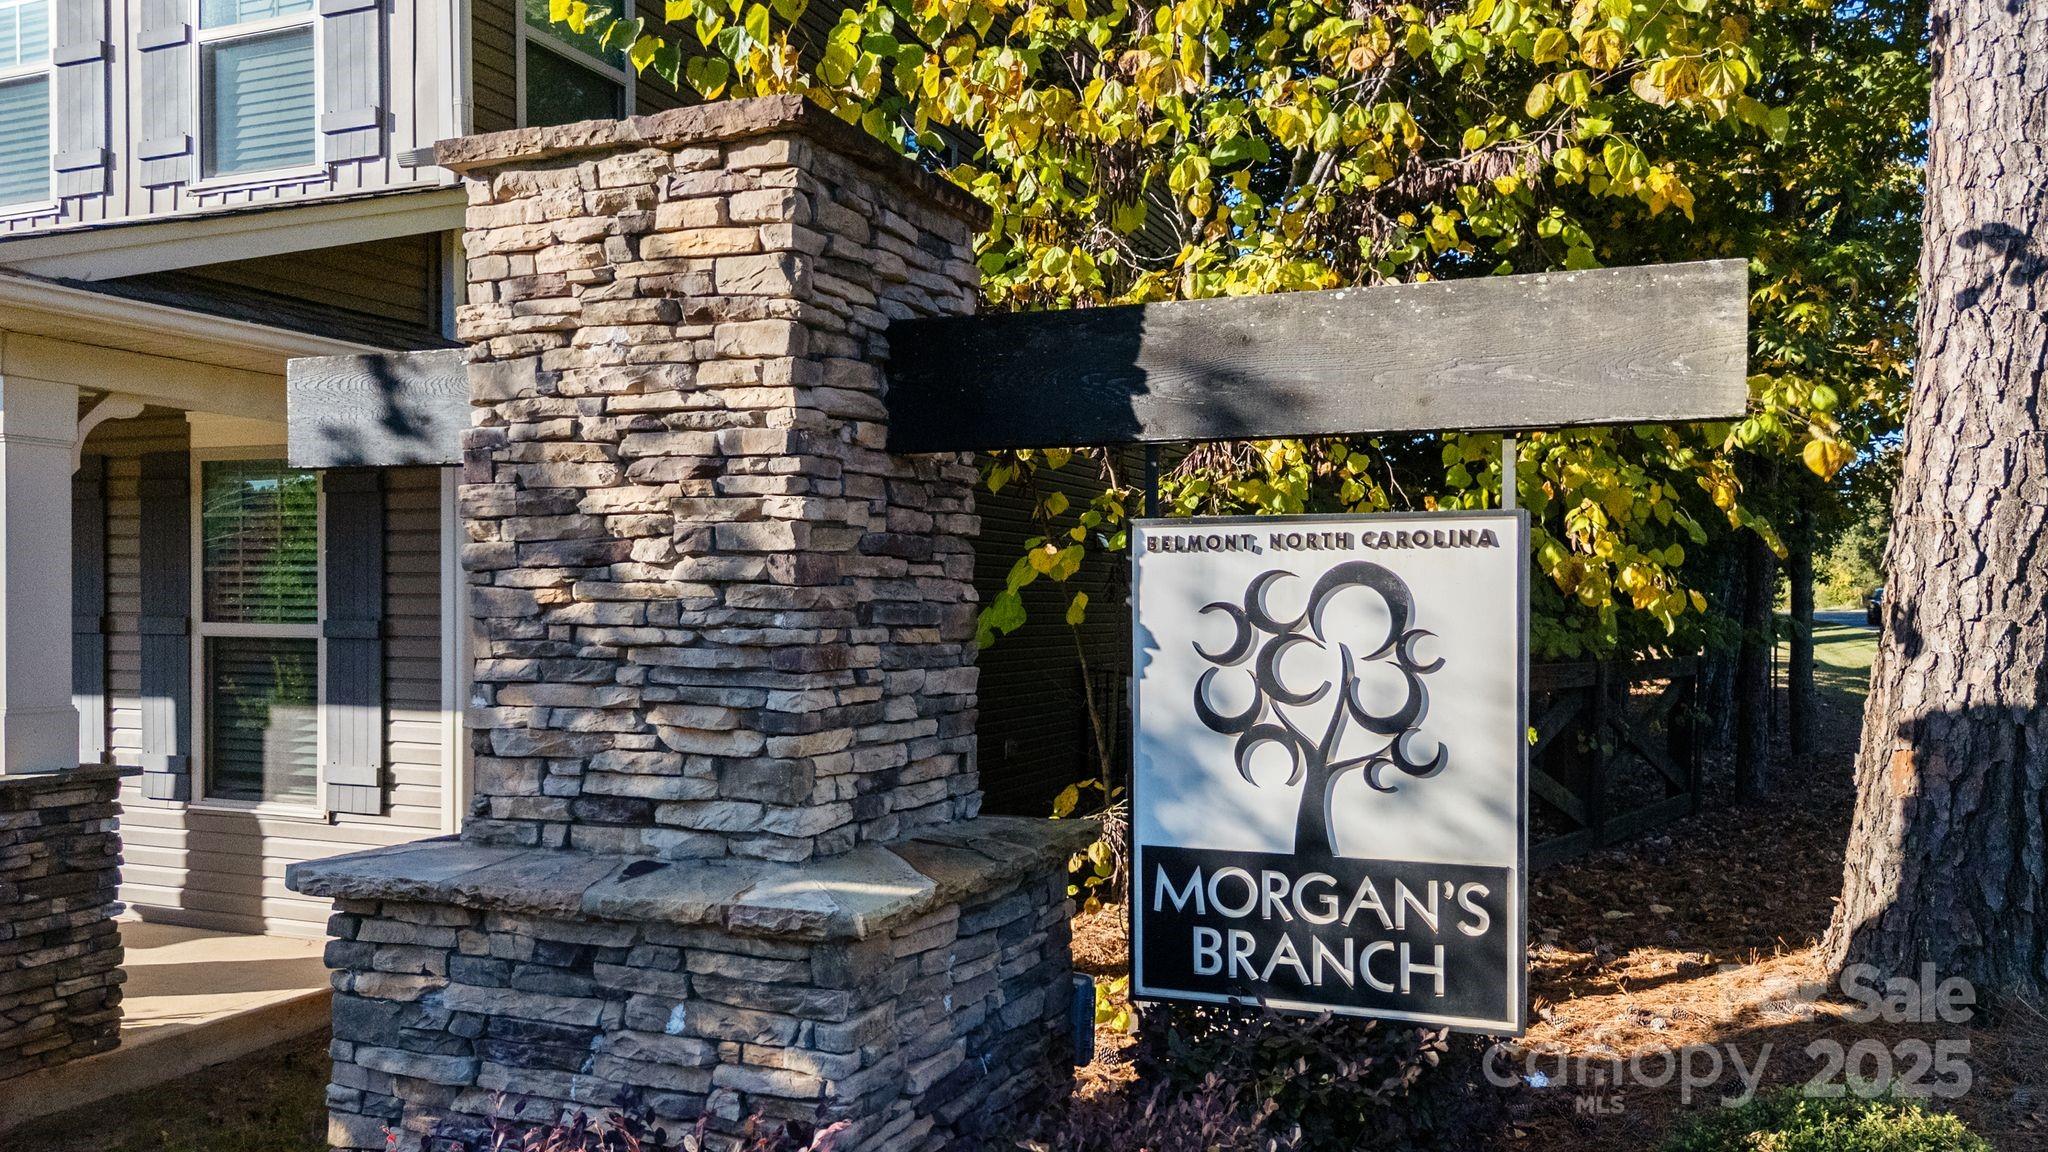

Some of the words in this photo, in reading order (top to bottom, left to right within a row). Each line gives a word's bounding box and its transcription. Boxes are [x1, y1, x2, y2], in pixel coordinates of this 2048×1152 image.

[1147, 534, 1262, 555] BELMONT,
[1269, 531, 1355, 551] NORTH
[1361, 528, 1500, 549] CAROLINA
[1153, 862, 1491, 937] MORGAN'S
[1192, 925, 1444, 997] BRANCH
